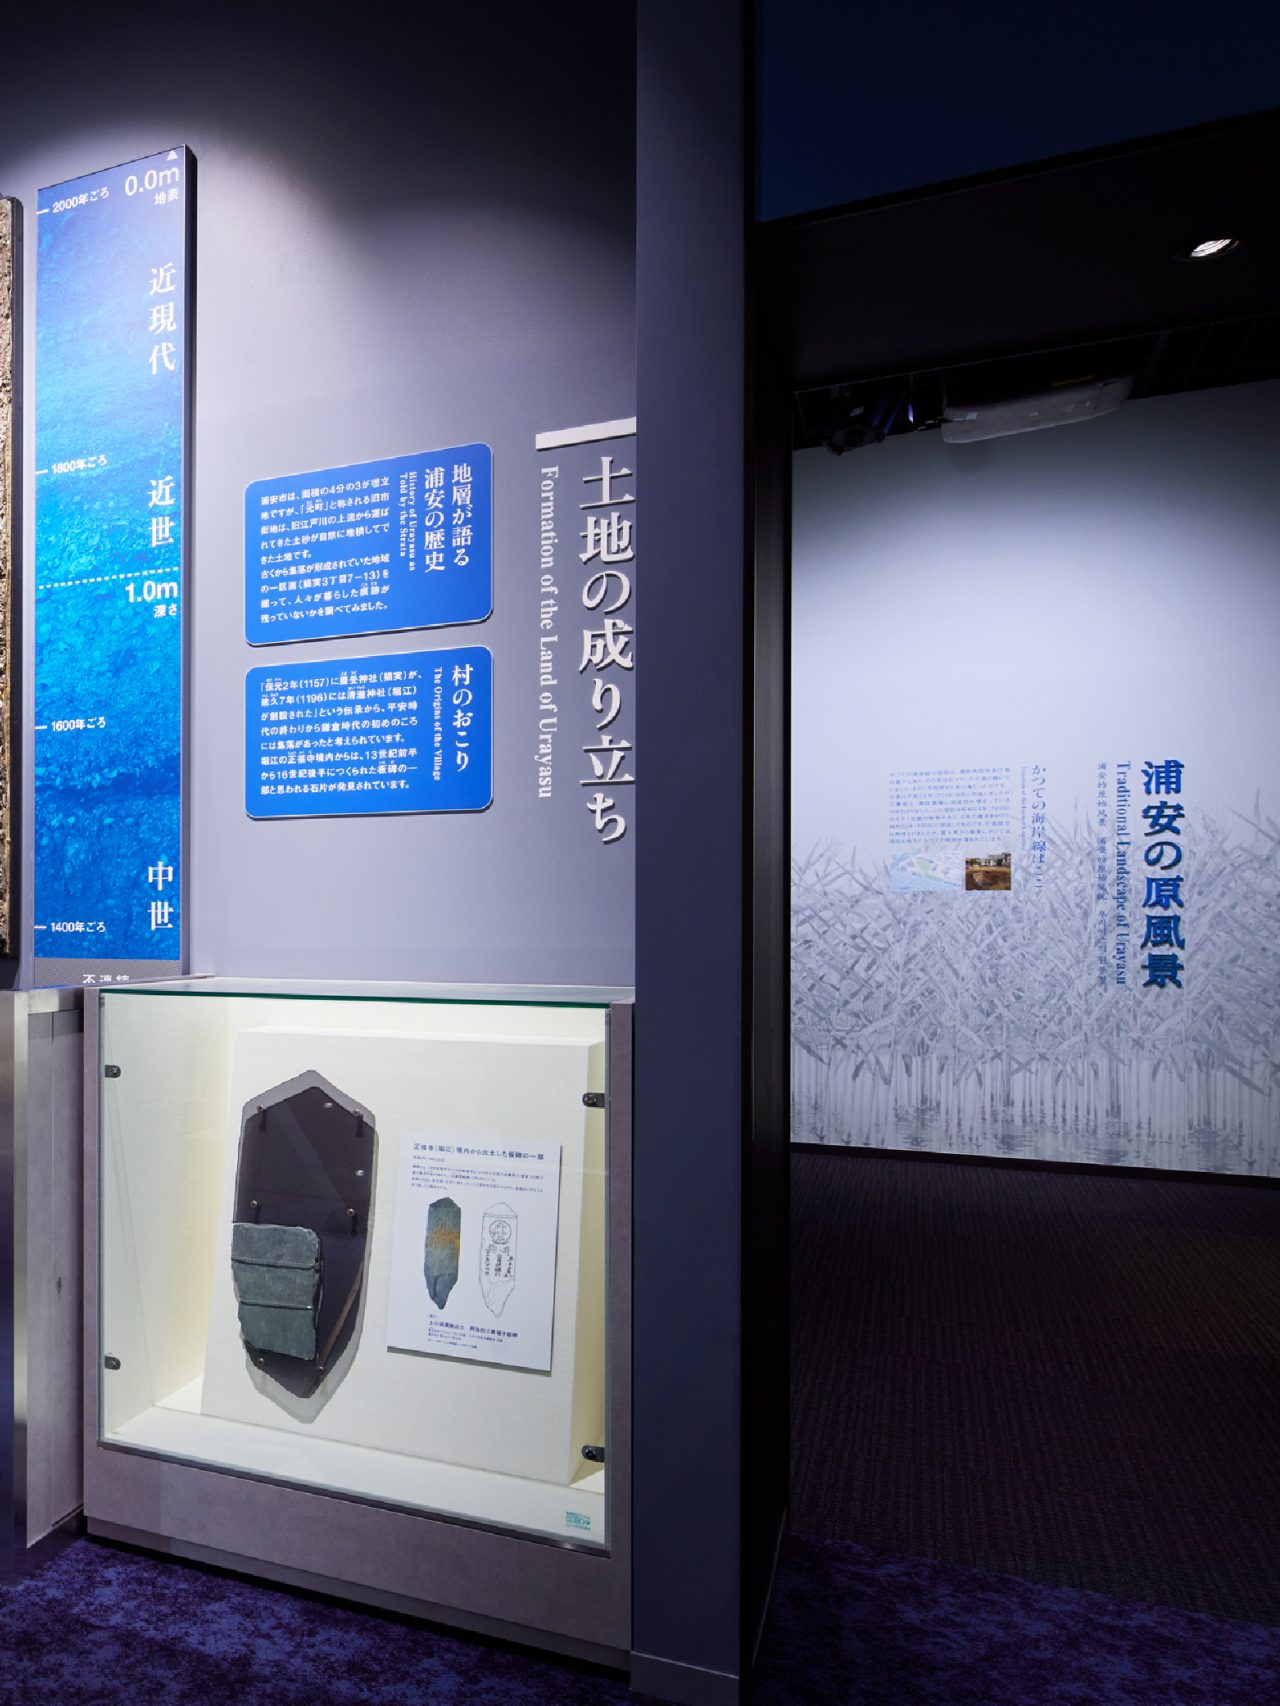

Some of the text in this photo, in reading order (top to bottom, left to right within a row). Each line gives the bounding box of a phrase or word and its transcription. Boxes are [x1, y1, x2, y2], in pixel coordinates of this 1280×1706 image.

[52, 186, 109, 214] 2000年ごろ
[125, 167, 179, 196] 0.0m
[154, 188, 179, 205] 地表
[148, 262, 177, 375] 近現代
[51, 454, 108, 475] 1800年ごろ
[408, 471, 417, 506] History
[148, 475, 176, 547] 近世
[398, 472, 408, 557] Told by the Strata
[408, 508, 417, 519] of
[408, 520, 417, 559] Urayasu
[424, 467, 446, 573] 浦安の歴史
[451, 463, 473, 567] 地層が語る
[125, 580, 178, 603] 1.0m
[261, 549, 311, 565] きた土地です。
[153, 603, 178, 618] 深さ
[535, 465, 559, 798] Formation of the Land of Urayasu
[578, 456, 636, 845] 土地の成り立ち
[50, 716, 107, 732] 1600年ごろ
[432, 666, 442, 781] The Origins of the Village
[451, 663, 474, 772] 村のおこり
[1031, 765, 1046, 888] かつての海岸線はここ
[147, 861, 174, 931] 中世
[1112, 760, 1131, 985] Traditional Landscape of Urayasu
[1140, 759, 1186, 989] 浦安の原風景
[50, 921, 106, 933] 1400年ごろ
